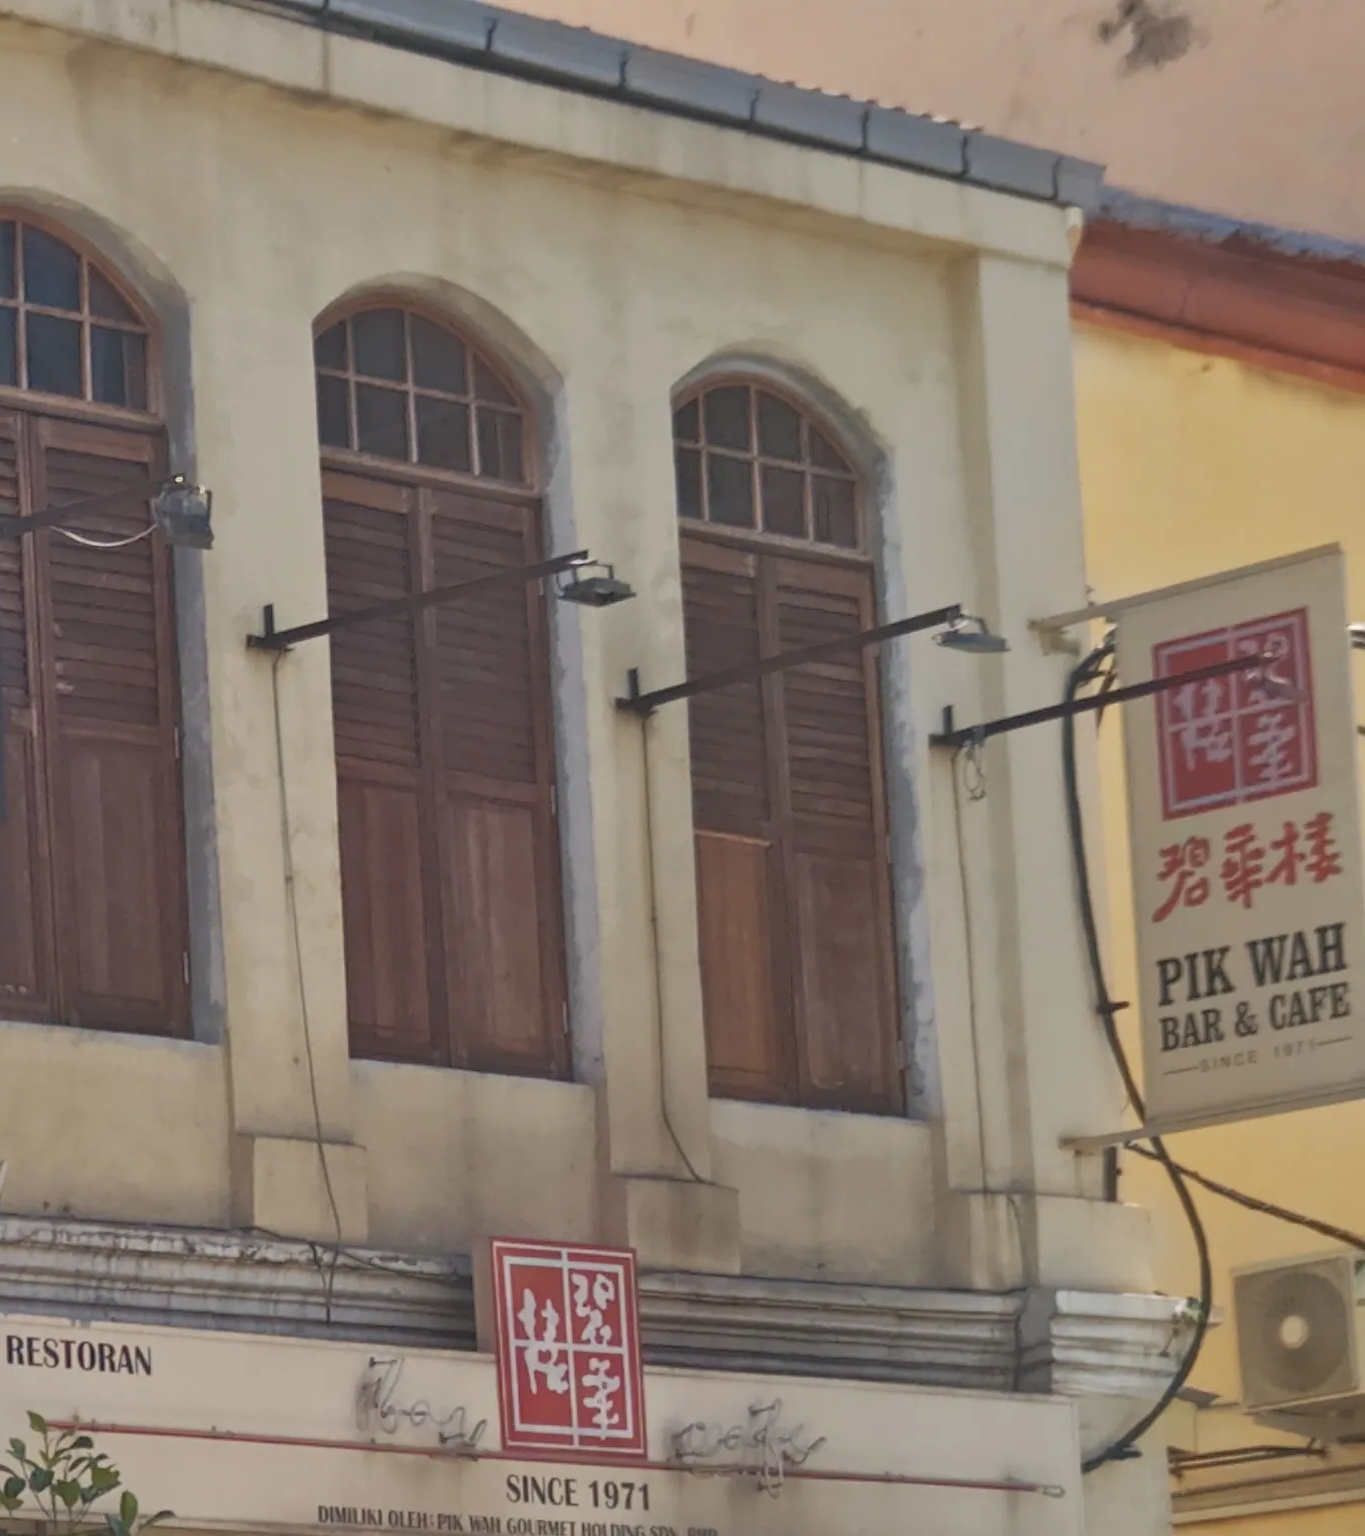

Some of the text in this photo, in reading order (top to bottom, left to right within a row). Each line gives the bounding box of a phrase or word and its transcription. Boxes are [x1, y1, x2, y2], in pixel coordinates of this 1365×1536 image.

[1156, 921, 1348, 1007] PIK WAH
[1159, 982, 1351, 1052] BAR & CAFE
[1198, 1050, 1259, 1073] SINCE
[5, 1334, 153, 1376] RESTORAN
[507, 1474, 651, 1512] SINCE 1971
[317, 1505, 384, 1528] DIMILIKI
[437, 1514, 464, 1533] PIK
[468, 1515, 502, 1535] WAH
